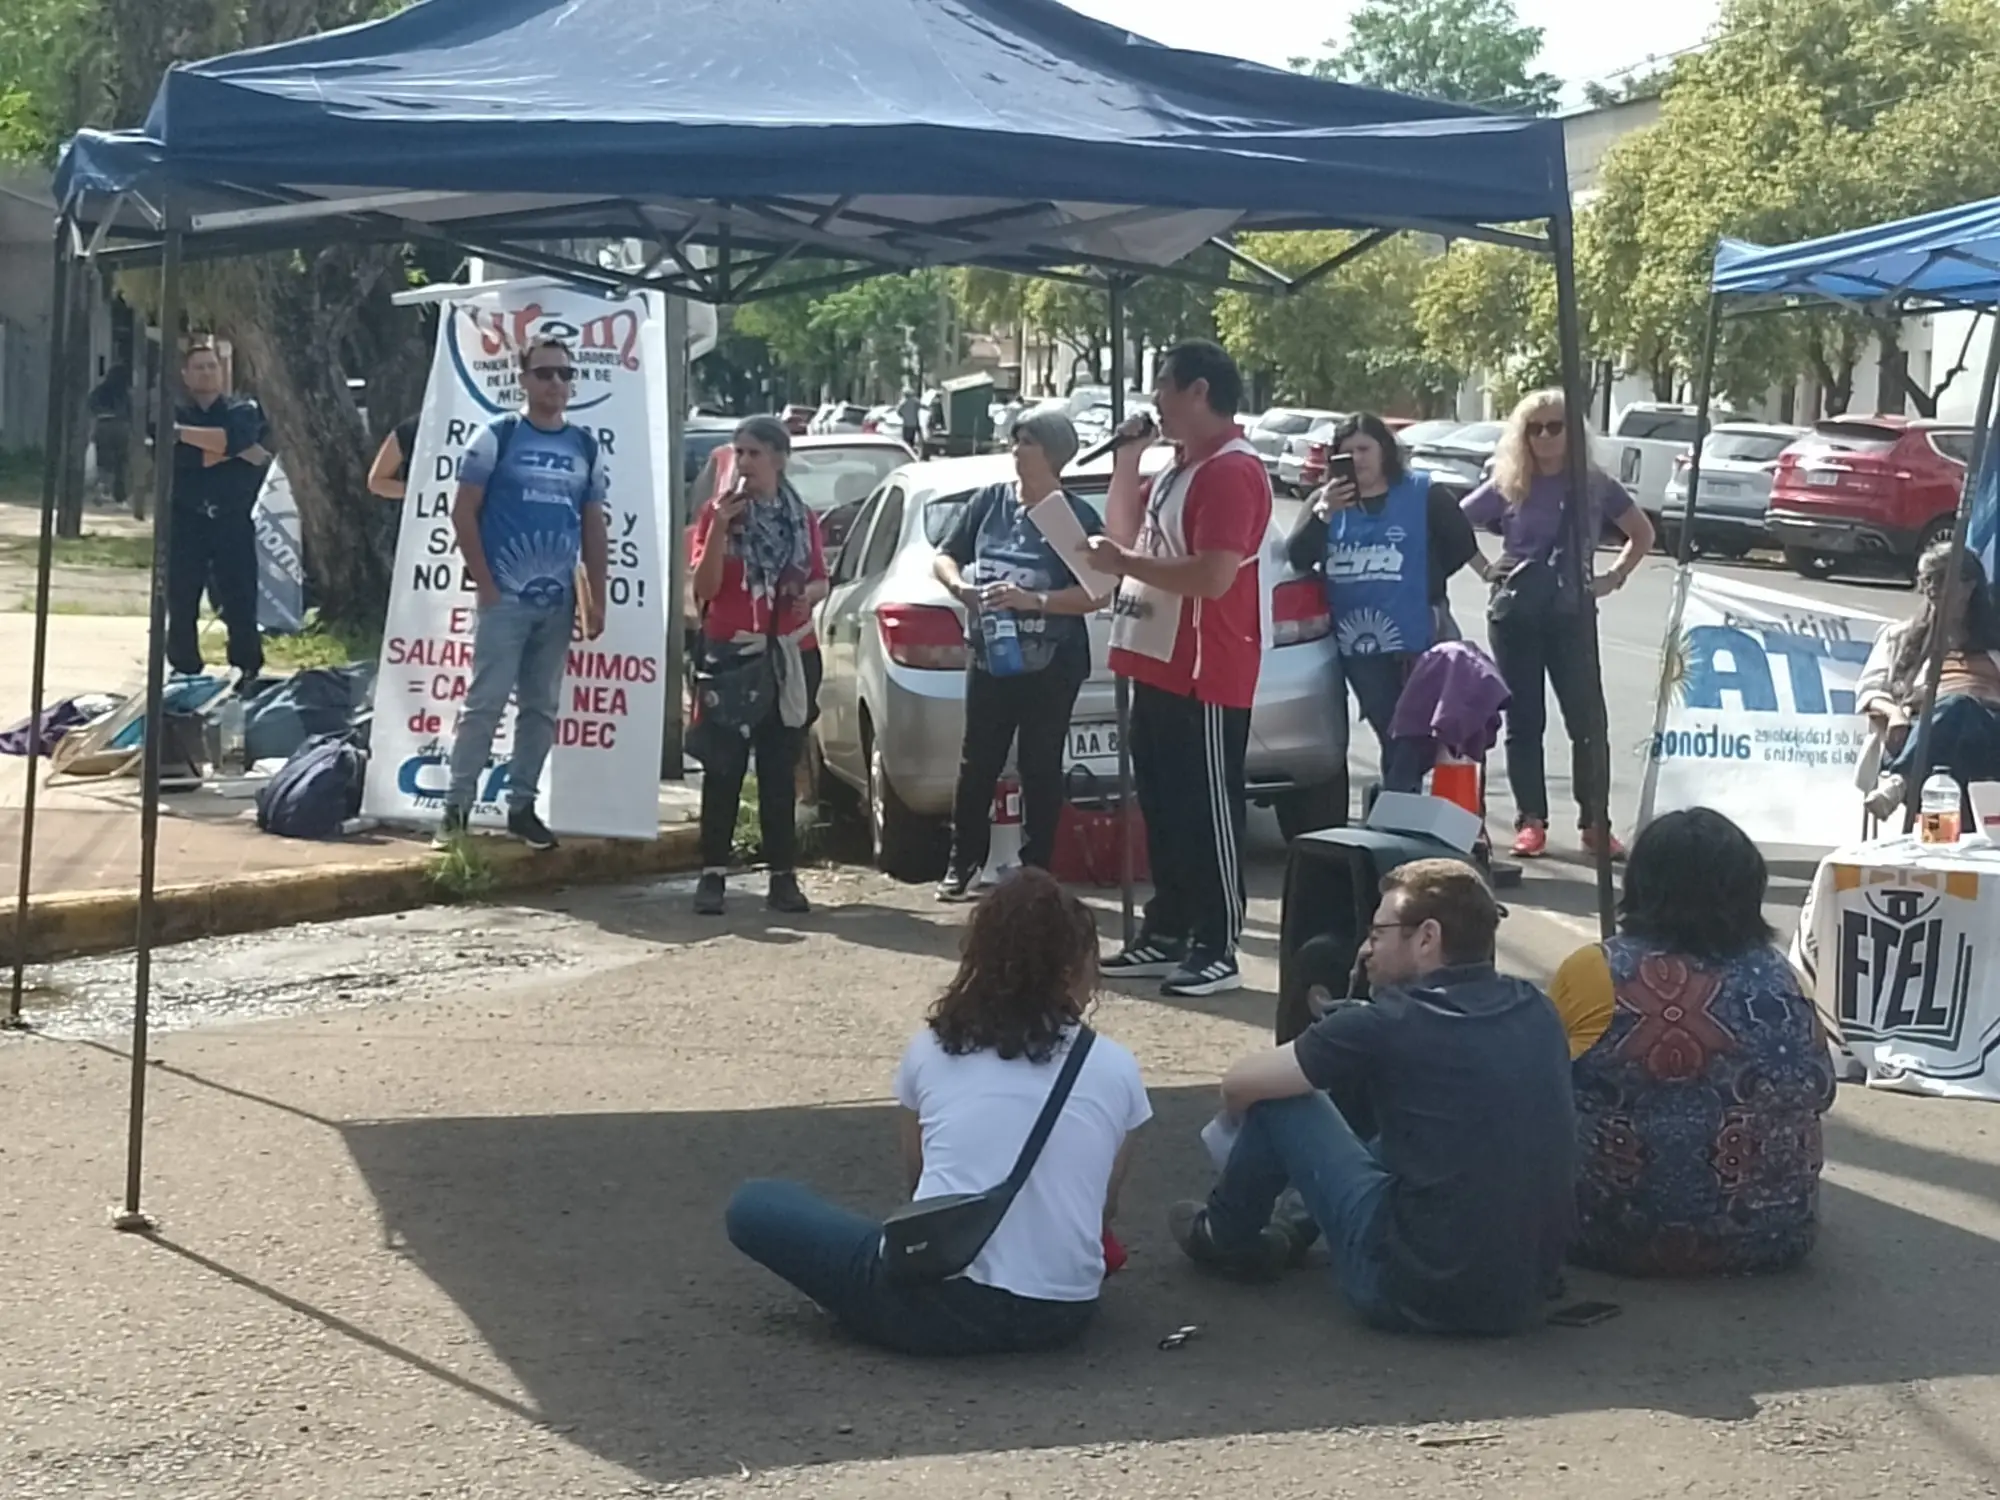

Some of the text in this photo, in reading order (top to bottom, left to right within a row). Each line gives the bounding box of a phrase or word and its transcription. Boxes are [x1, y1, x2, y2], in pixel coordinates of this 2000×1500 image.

[412, 564, 451, 591] NO
[386, 637, 657, 683] SALAR NIMOS
[573, 684, 628, 716] NEA
[408, 707, 441, 733] de
[1076, 732, 1101, 755] AA
